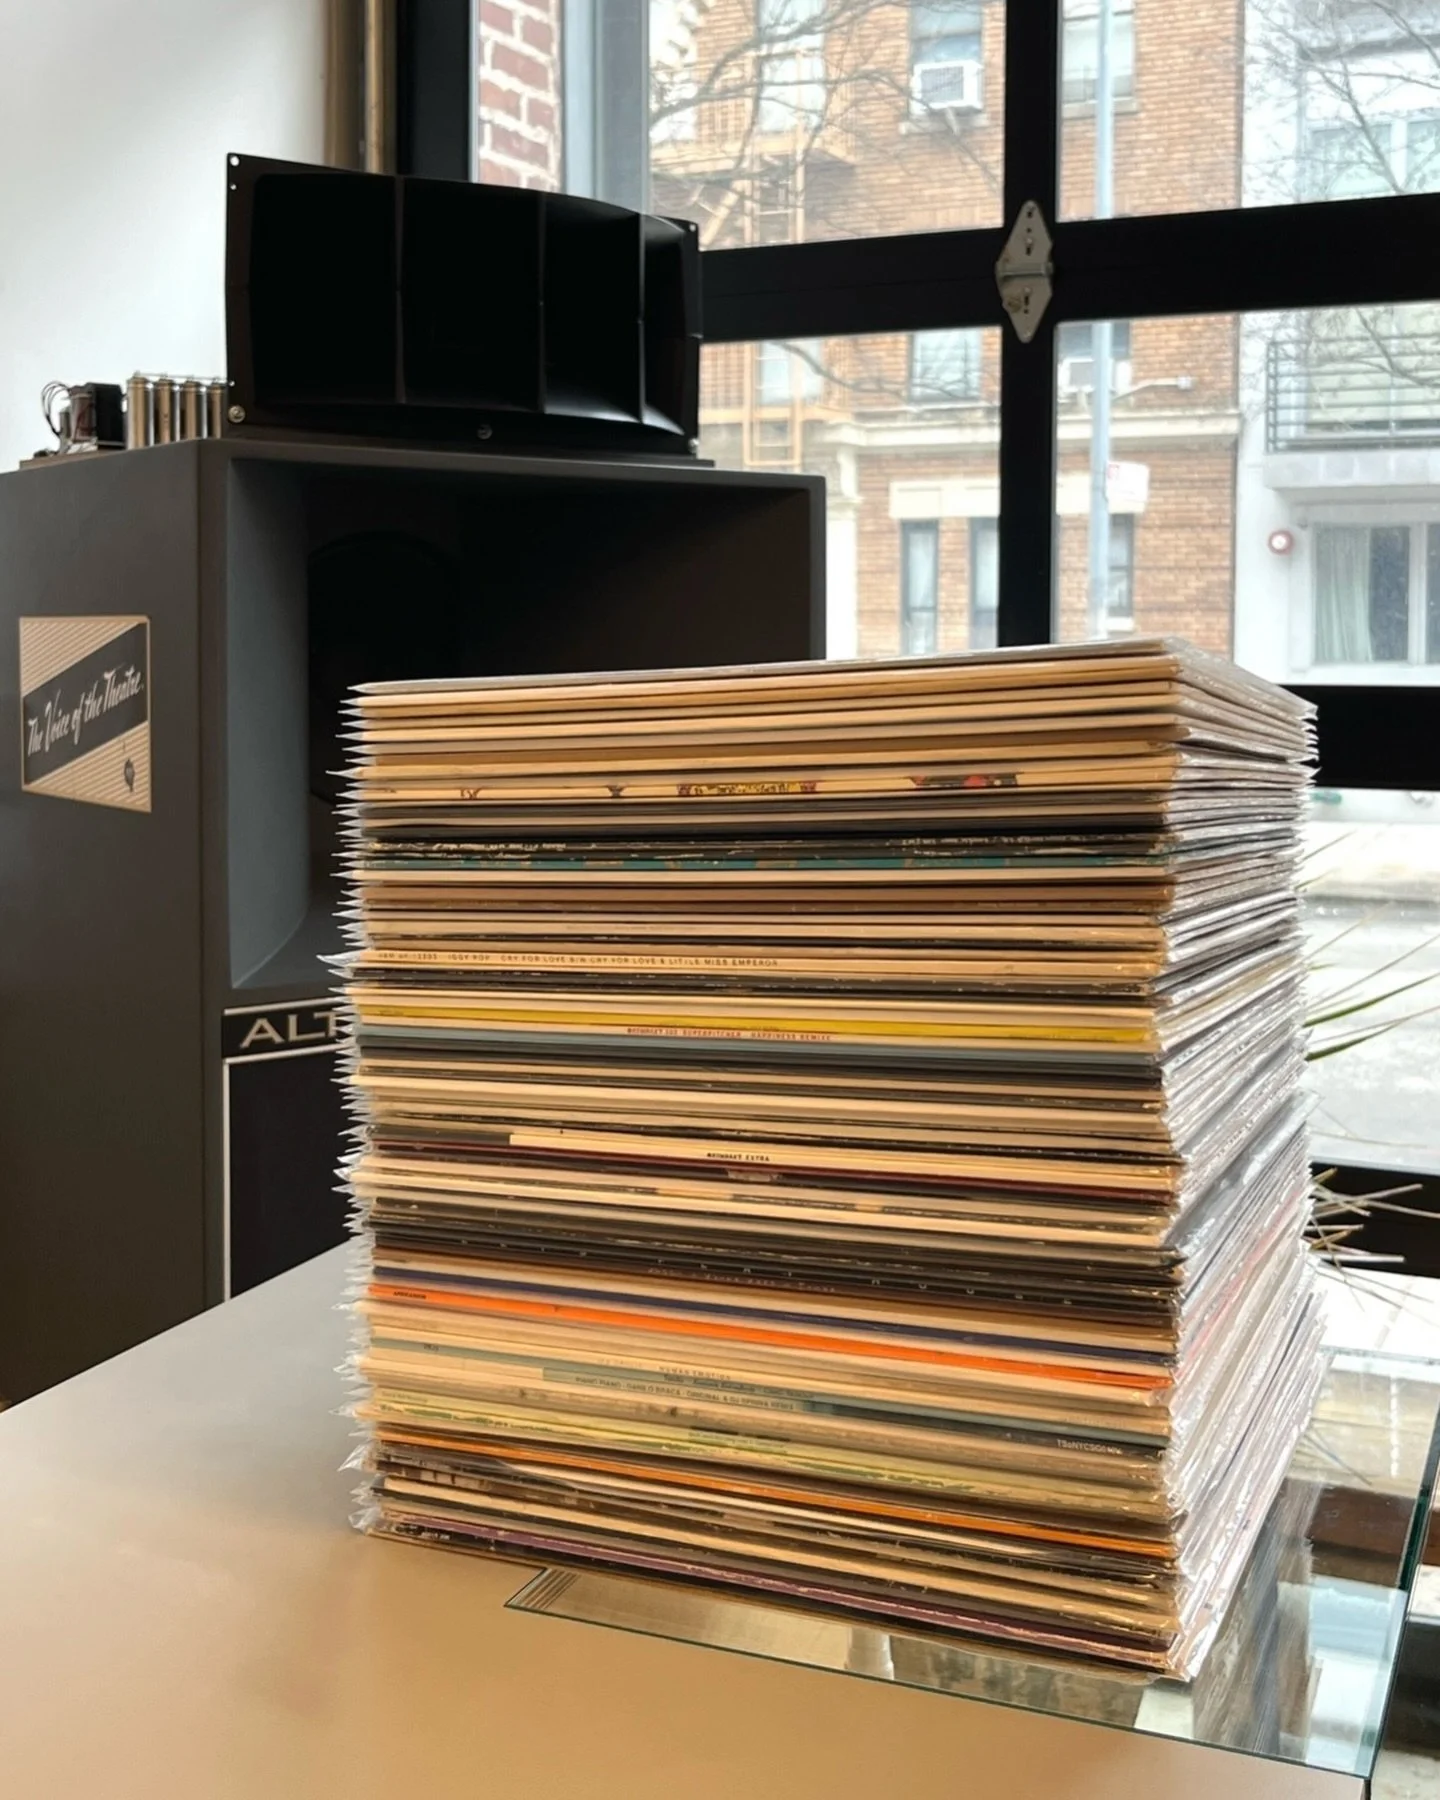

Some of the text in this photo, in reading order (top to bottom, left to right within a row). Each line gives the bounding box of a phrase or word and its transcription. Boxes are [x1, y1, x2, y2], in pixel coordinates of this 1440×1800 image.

[28, 717, 44, 756] The
[45, 689, 70, 752] Voice
[72, 692, 85, 745] of
[85, 680, 103, 722] the
